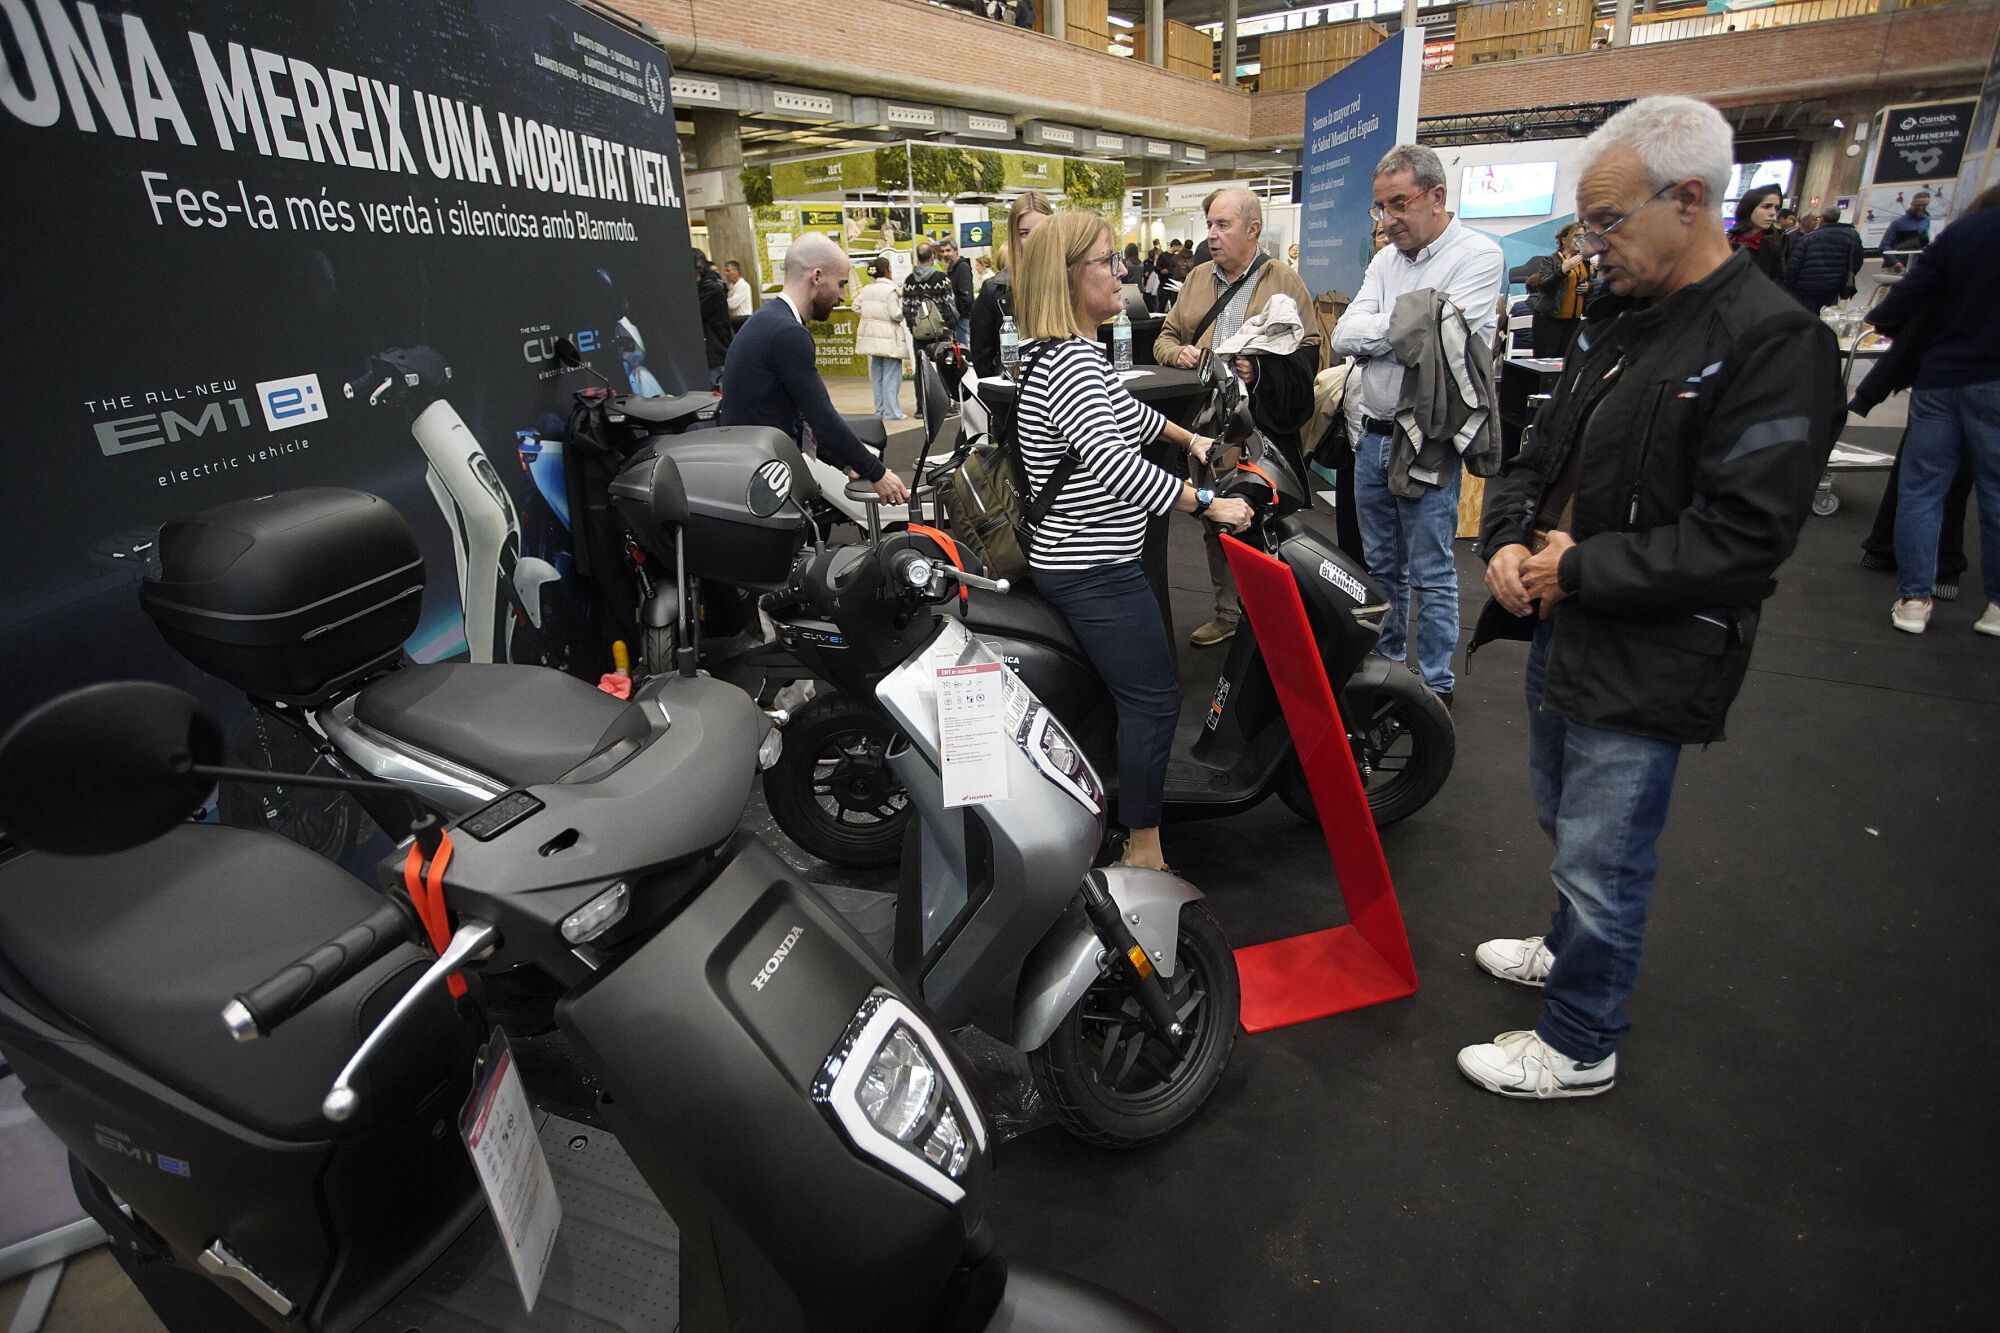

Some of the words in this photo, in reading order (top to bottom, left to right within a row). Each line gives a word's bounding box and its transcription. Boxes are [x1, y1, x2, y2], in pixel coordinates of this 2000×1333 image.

[188, 31, 418, 175] MEREIX
[413, 90, 502, 186] UNA
[498, 111, 628, 203] MOBILITAT
[628, 146, 681, 209] NETA.
[1331, 125, 1349, 148] Mental
[1349, 127, 1357, 140] en
[1357, 113, 1379, 139] España
[1333, 104, 1350, 123] mayor
[1350, 93, 1361, 114] red
[141, 170, 279, 230] Fes-la
[285, 186, 356, 232] més
[359, 195, 434, 235] verda
[434, 198, 446, 235] i
[449, 200, 540, 239] silenciosa
[542, 210, 575, 240] amb
[577, 211, 639, 242] Blanmoto.
[84, 396, 134, 413] THE
[145, 379, 238, 404] ALL-NEW
[93, 398, 250, 456] EM1
[158, 456, 239, 487] electric
[248, 438, 310, 463] vehicle
[1321, 566, 1364, 602] BLANMOTO
[750, 926, 804, 992] HONDA
